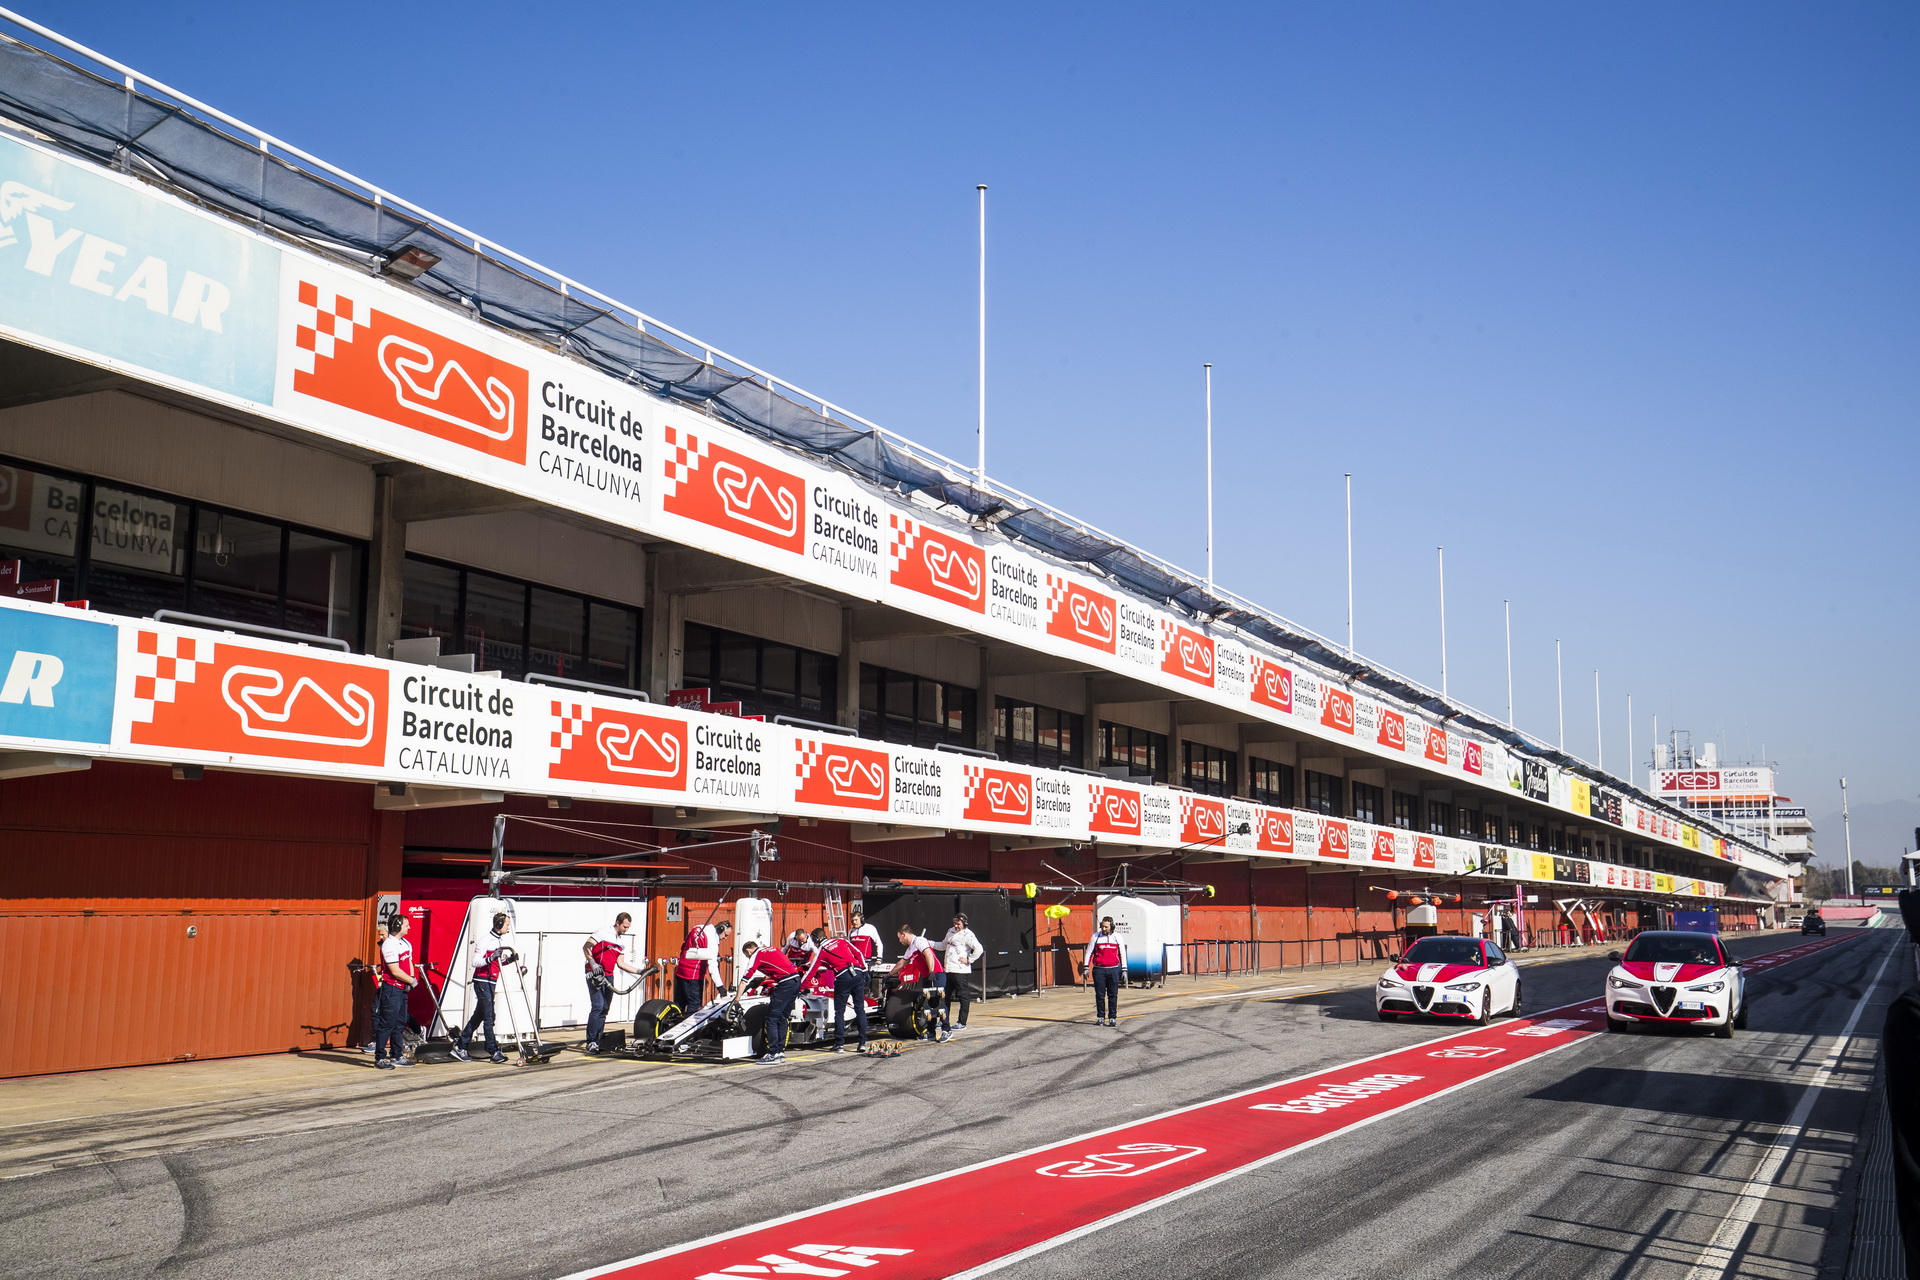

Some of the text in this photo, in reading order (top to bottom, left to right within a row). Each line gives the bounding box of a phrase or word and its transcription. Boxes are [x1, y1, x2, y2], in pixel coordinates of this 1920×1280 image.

[541, 381, 643, 441] Circuit de
[541, 414, 643, 473] Barcelona
[538, 450, 642, 503] CATALUNYA
[47, 486, 171, 532] Bacelona
[813, 486, 879, 530] Circuit de
[813, 513, 879, 555] Barcelona
[812, 542, 878, 579] CATALUNYA
[991, 555, 1037, 588] Circuit de
[24, 583, 52, 594] Santander
[992, 578, 1037, 610] Barcelona
[990, 602, 1037, 631] CATALUNYA
[1120, 604, 1155, 631] Circuit de
[1120, 623, 1154, 649] Barcelona
[1120, 645, 1154, 667] CATALUNYA
[1217, 644, 1244, 666] Circuit de
[1217, 661, 1245, 682] Barcelona
[402, 676, 515, 717] Circuit de
[401, 711, 514, 750] Barcelona
[695, 725, 761, 753] Circuit de
[399, 747, 511, 780] CATALUNYA
[695, 750, 761, 777] Barcelona
[894, 755, 941, 778] Circuit de
[694, 776, 760, 799] CATALUNYA
[895, 777, 941, 798] Barcelona
[1035, 777, 1070, 795] Circuit de
[894, 799, 941, 816] CATALUNYA
[1036, 796, 1071, 812] Barcelona
[1143, 793, 1170, 809] Circuit de
[1227, 805, 1244, 819] Circuit
[1035, 814, 1070, 829] CATALUNYA
[1144, 810, 1171, 824] Barcelona
[379, 907, 398, 919] 42
[668, 901, 680, 915] 41
[1250, 1073, 1425, 1114] Barcelona
